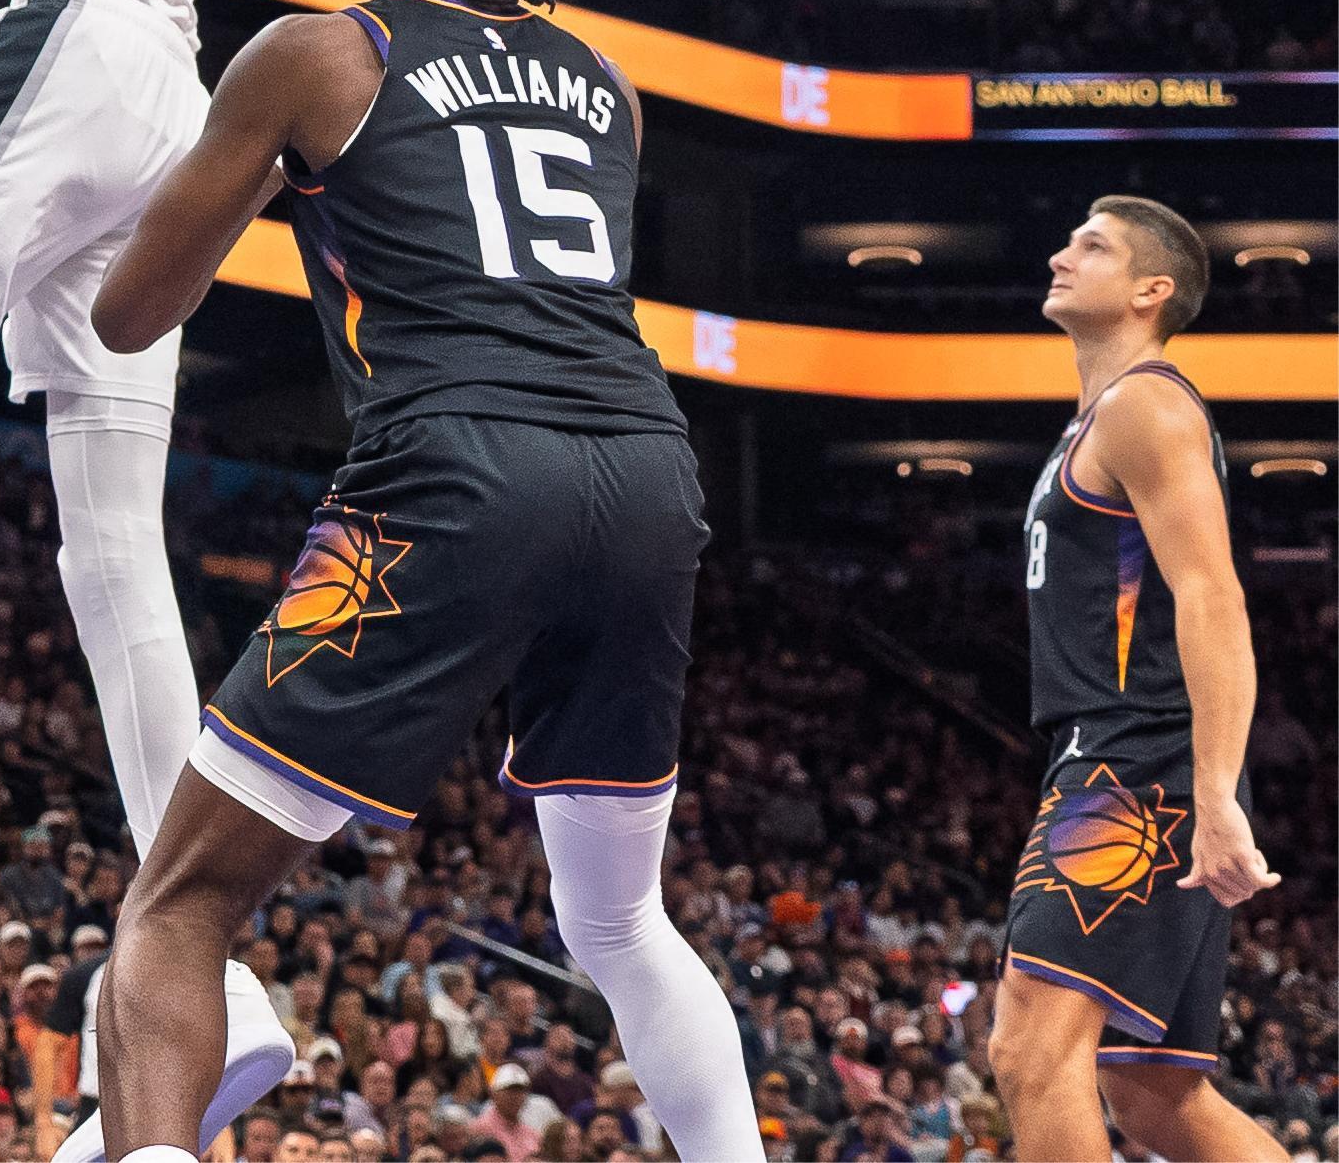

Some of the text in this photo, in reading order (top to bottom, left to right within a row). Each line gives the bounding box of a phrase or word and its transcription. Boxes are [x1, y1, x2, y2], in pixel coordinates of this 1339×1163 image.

[404, 54, 615, 134] WILLIAMS
[781, 62, 830, 125] DE
[975, 79, 1034, 108] SAN
[1034, 79, 1159, 107] ANTONIO
[451, 124, 617, 283] 15
